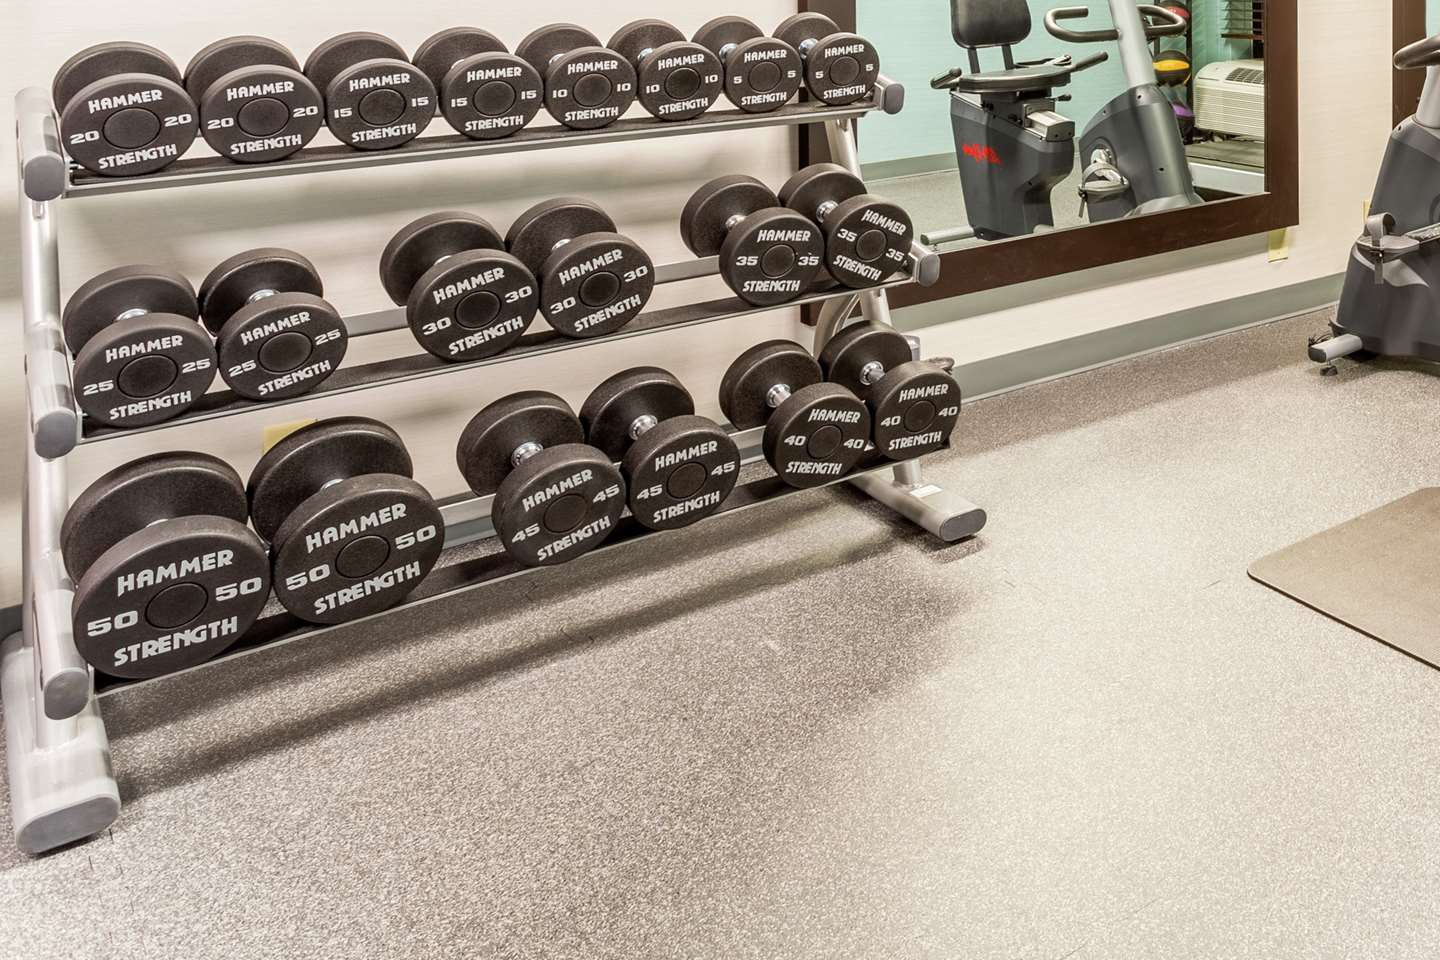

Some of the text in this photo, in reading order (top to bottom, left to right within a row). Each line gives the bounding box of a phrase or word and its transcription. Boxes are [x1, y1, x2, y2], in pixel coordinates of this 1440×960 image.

[658, 54, 704, 72] HAMMER
[744, 50, 787, 62] HAMMER
[825, 44, 864, 58] HAMMER
[467, 67, 521, 82] HAMMER
[568, 60, 618, 74] HAMMER
[227, 81, 294, 101] HAMMER
[350, 73, 410, 92] HAMMER
[553, 83, 631, 98] 10 10
[646, 75, 718, 93] 10 10
[824, 85, 870, 99] STRENGTH
[88, 90, 162, 113] HAMMER
[334, 97, 428, 118] 15 15
[452, 90, 536, 107] 15 15
[659, 98, 708, 114] STRENGTH
[742, 92, 786, 105] STRENGTH
[208, 106, 318, 129] 20 20
[465, 115, 523, 131] STRENGTH
[565, 107, 618, 121] STRENGTH
[70, 114, 191, 144] 20 20
[352, 123, 416, 142] STRENGTH
[231, 134, 301, 154] STRENGTH
[99, 144, 177, 169] STRENGTH
[861, 210, 906, 235] HAMMER
[757, 230, 810, 242] HAMMER
[838, 229, 904, 262] 35 35
[559, 249, 623, 285] HAMMER
[736, 256, 819, 266] 35 35
[833, 255, 881, 280] STRENGTH
[433, 268, 504, 304] HAMMER
[551, 266, 648, 314] 30 30
[743, 280, 800, 291] STRENGTH
[423, 286, 532, 335] 30 30
[574, 295, 645, 333] STRENGTH
[241, 312, 310, 345] HAMMER
[449, 316, 523, 355] STRENGTH
[106, 335, 182, 363] HAMMER
[229, 329, 340, 377] 25 25
[84, 359, 210, 395] 25 25
[258, 360, 331, 395] STRENGTH
[899, 384, 948, 402] HAMMER
[110, 391, 191, 420] STRENGTH
[808, 409, 860, 423] HAMMER
[881, 407, 957, 426] 40 40
[784, 436, 864, 448] 40 40
[889, 431, 941, 450] STRENGTH
[656, 441, 717, 471] HAMMER
[786, 462, 842, 474] STRENGTH
[522, 470, 592, 512] HAMMER
[637, 462, 735, 499] 45 45
[512, 484, 619, 542] 45 45
[654, 491, 719, 522] STRENGTH
[306, 504, 406, 553] HAMMER
[537, 516, 610, 561] STRENGTH
[286, 525, 436, 590] 50 50
[118, 550, 233, 596] HAMMER
[314, 561, 420, 614] STRENGTH
[88, 577, 261, 636] 50 50
[114, 616, 237, 666] STRENGTH
